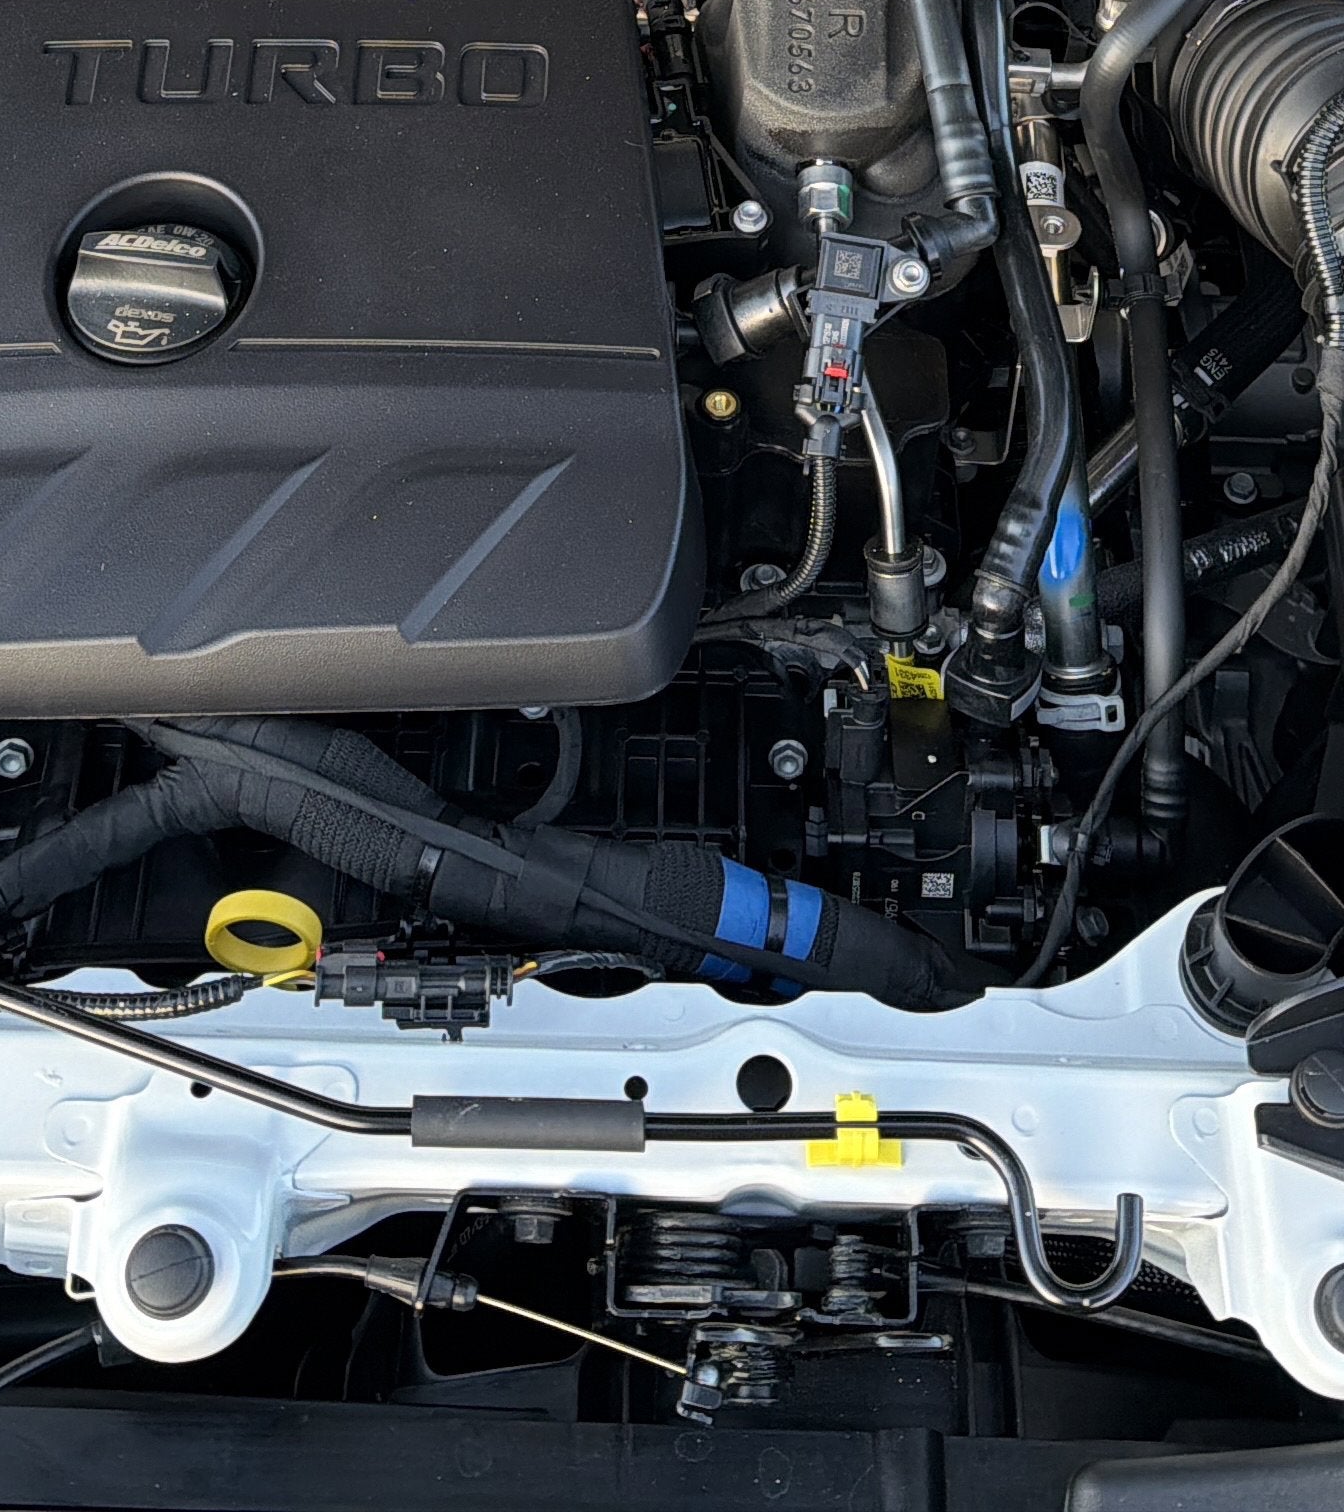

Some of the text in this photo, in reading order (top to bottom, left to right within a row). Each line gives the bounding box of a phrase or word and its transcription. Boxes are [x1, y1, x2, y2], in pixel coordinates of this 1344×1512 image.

[828, 7, 867, 40] R
[42, 38, 550, 107] TURBO
[97, 233, 208, 259] ACDelco
[114, 304, 178, 324] dexos
[1199, 354, 1226, 381] ENG
